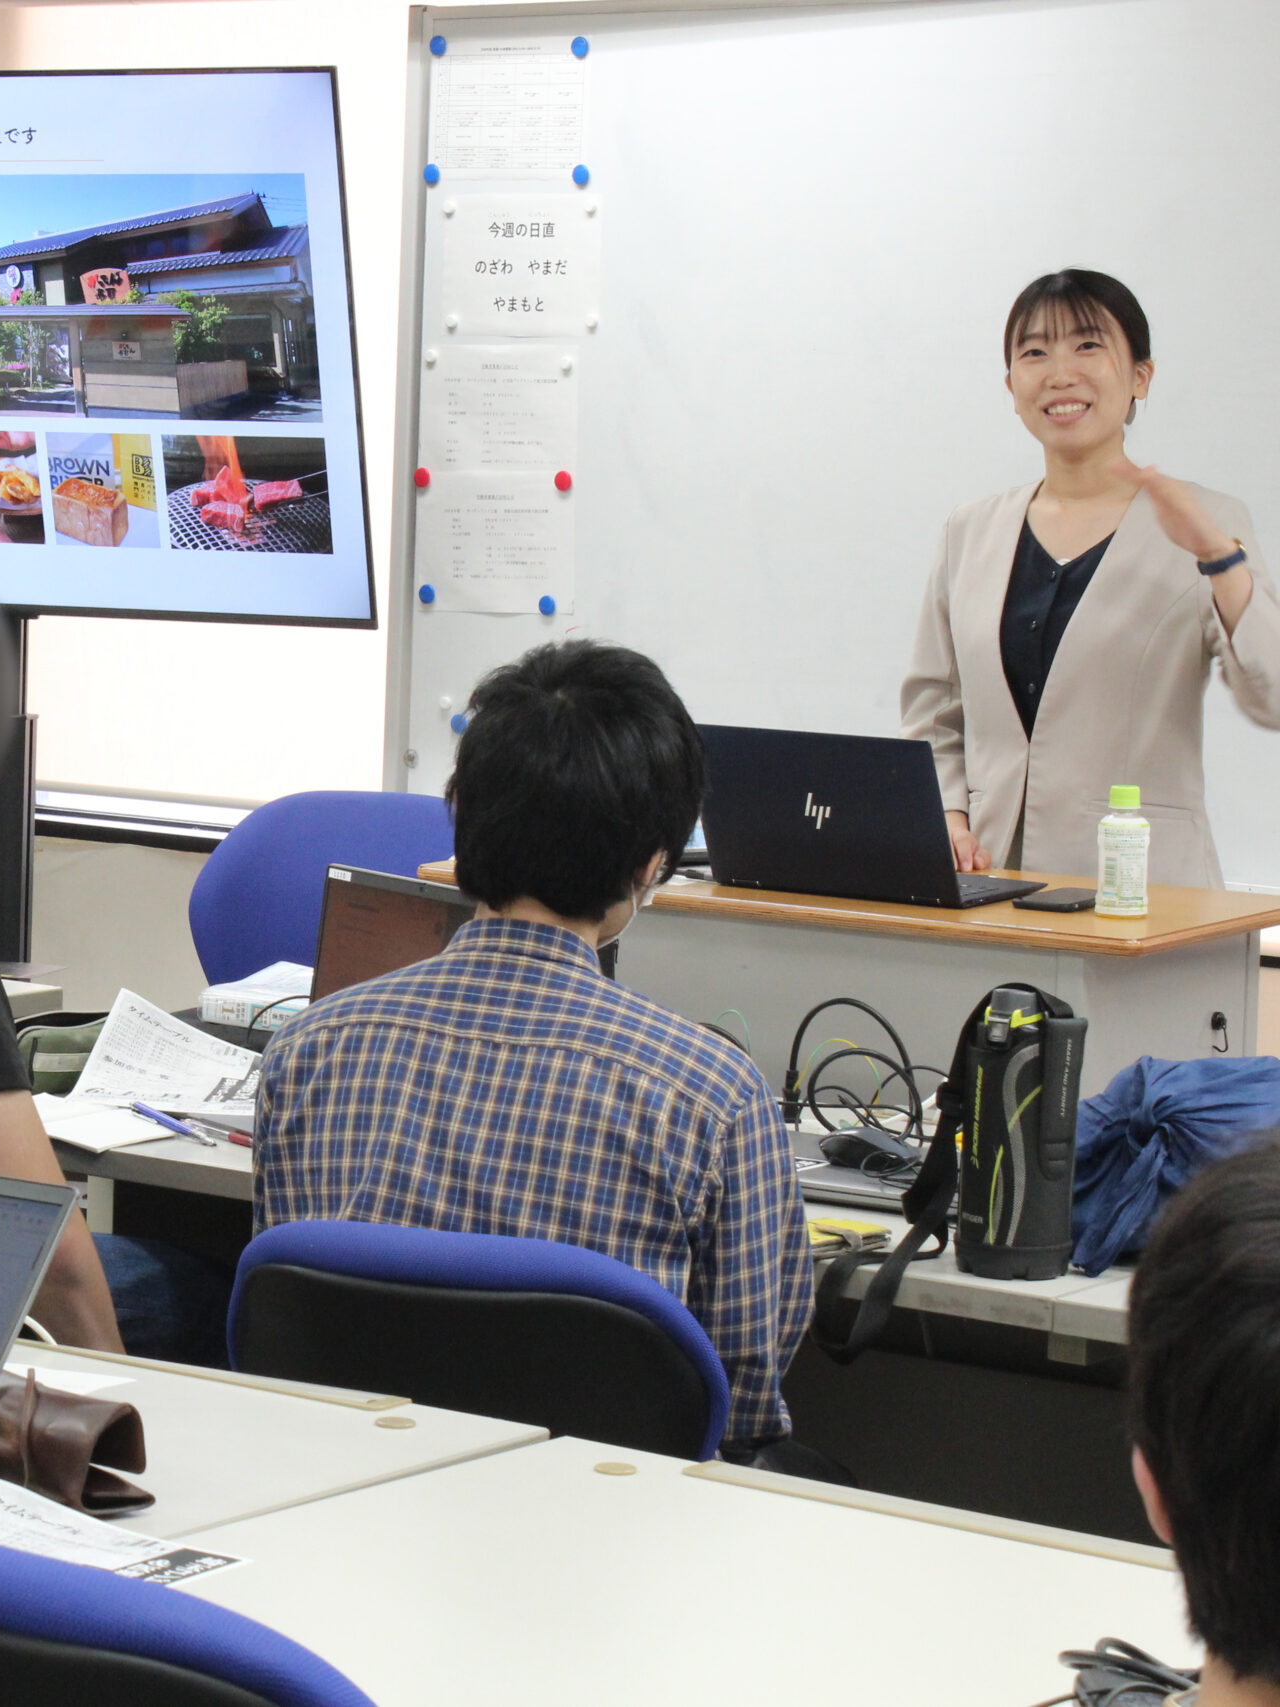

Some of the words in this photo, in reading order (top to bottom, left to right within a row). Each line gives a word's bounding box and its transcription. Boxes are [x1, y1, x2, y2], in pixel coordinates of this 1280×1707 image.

[488, 221, 556, 238] 今週の日直
[474, 258, 513, 275] のざわ
[527, 258, 568, 275] やまだ
[493, 296, 545, 313] やまもと
